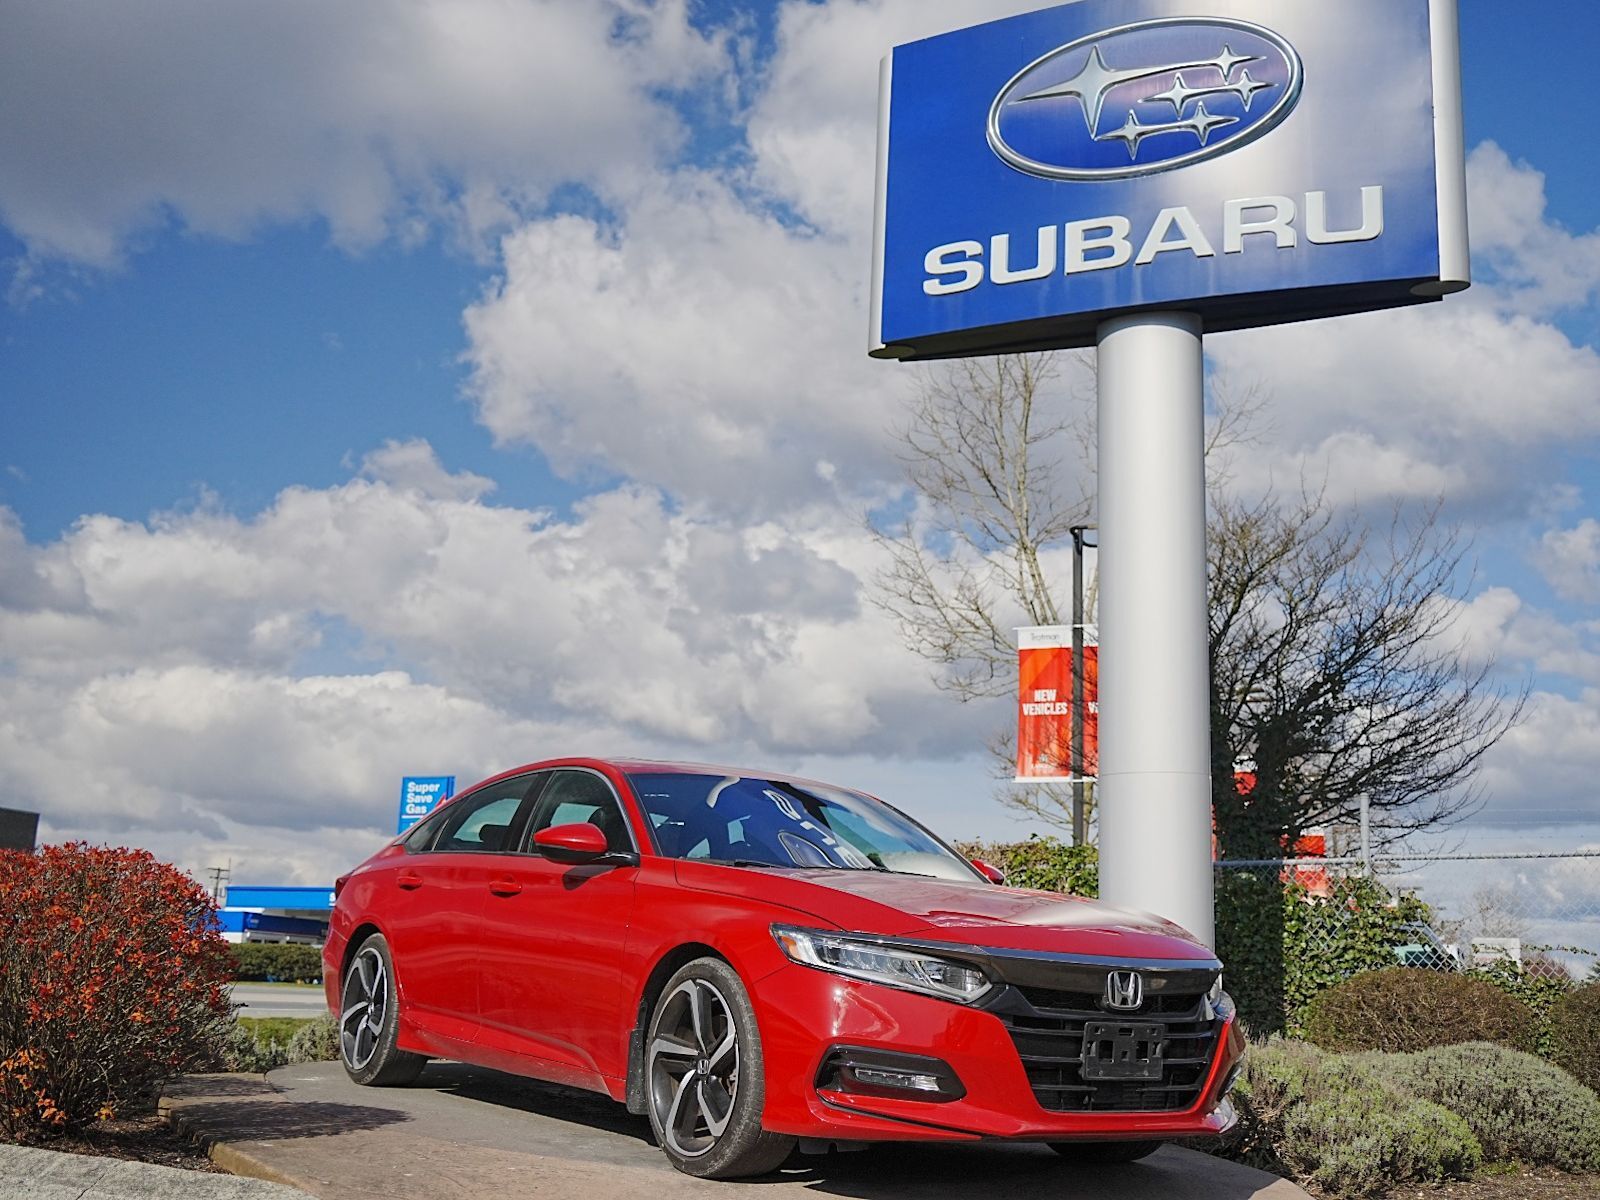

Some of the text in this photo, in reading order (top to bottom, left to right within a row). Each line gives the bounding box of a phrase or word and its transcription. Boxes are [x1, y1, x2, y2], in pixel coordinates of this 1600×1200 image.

[922, 185, 1383, 296] SUBARU
[1034, 689, 1057, 702] NEW
[1022, 702, 1068, 716] VEHICLES
[407, 781, 440, 794] Super
[407, 793, 433, 804] Save
[405, 803, 427, 814] Gas
